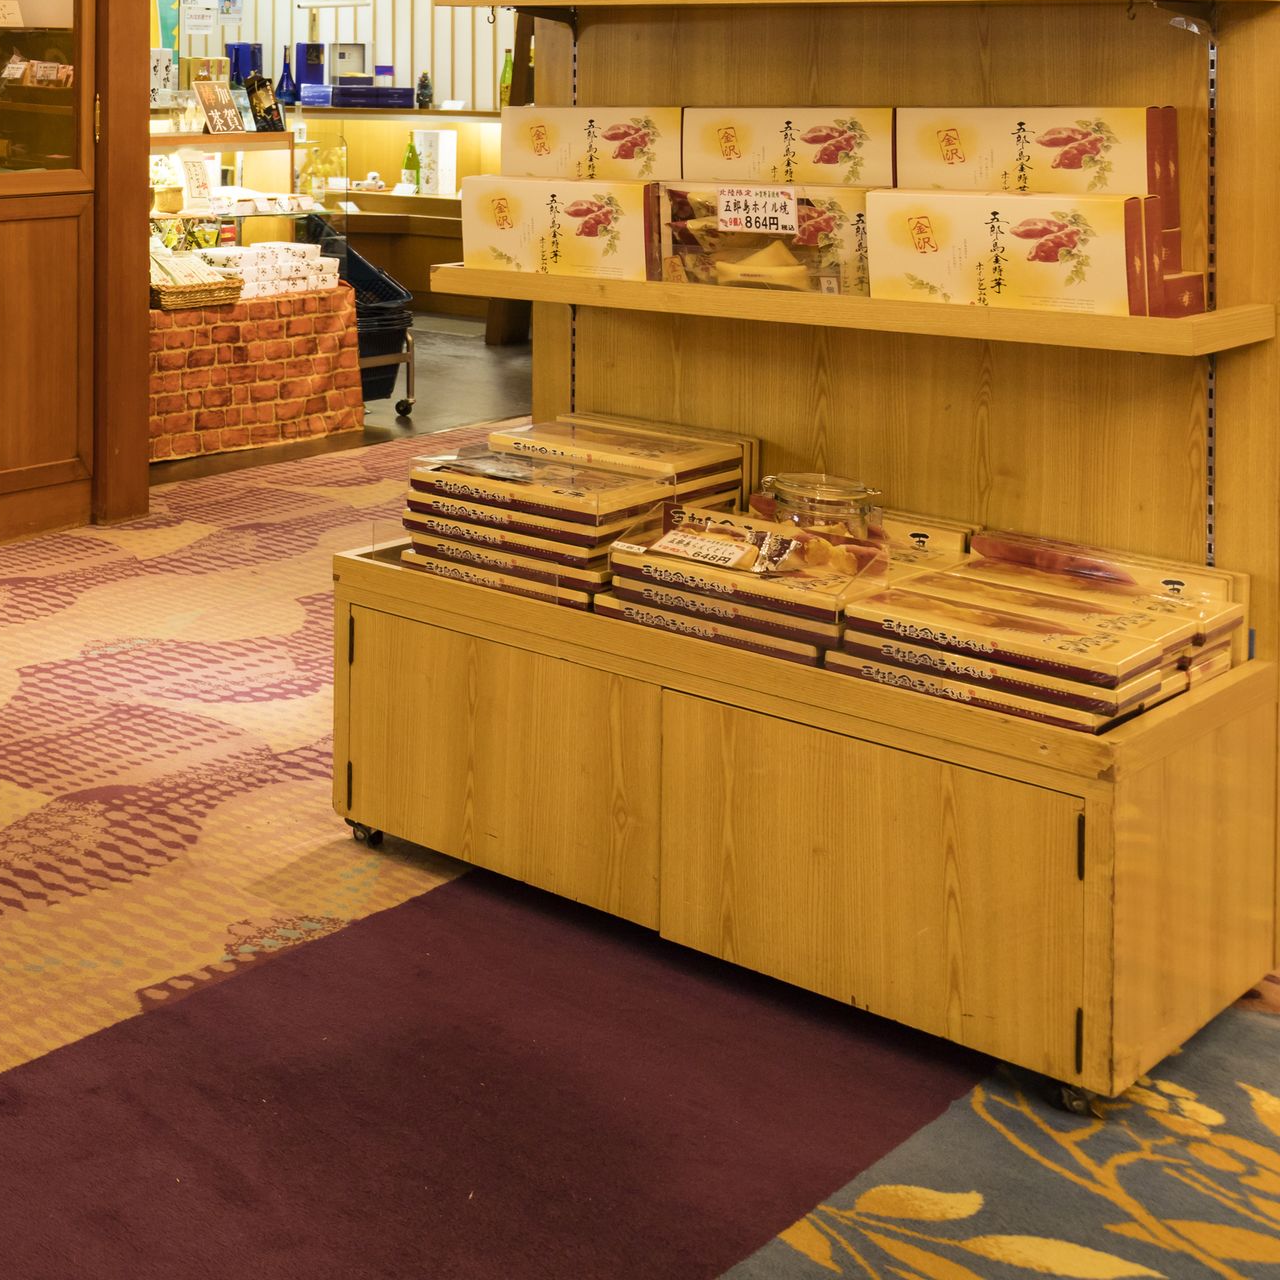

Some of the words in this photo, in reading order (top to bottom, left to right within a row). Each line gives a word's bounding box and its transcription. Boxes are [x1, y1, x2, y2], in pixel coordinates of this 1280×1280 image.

[200, 85, 227, 132] 棒茶
[214, 85, 243, 131] 加賀
[533, 129, 549, 153] 金沢
[721, 130, 740, 156] 金沢
[941, 133, 964, 161] 金沢
[720, 189, 752, 197] 北陸限定
[495, 202, 511, 226] 金沢
[724, 199, 790, 215] 五郎島ホイル焼
[745, 215, 779, 231] 864円
[913, 221, 936, 250] 金沢
[985, 211, 1010, 294] 五郎島金時芋
[692, 550, 731, 564] 648円
